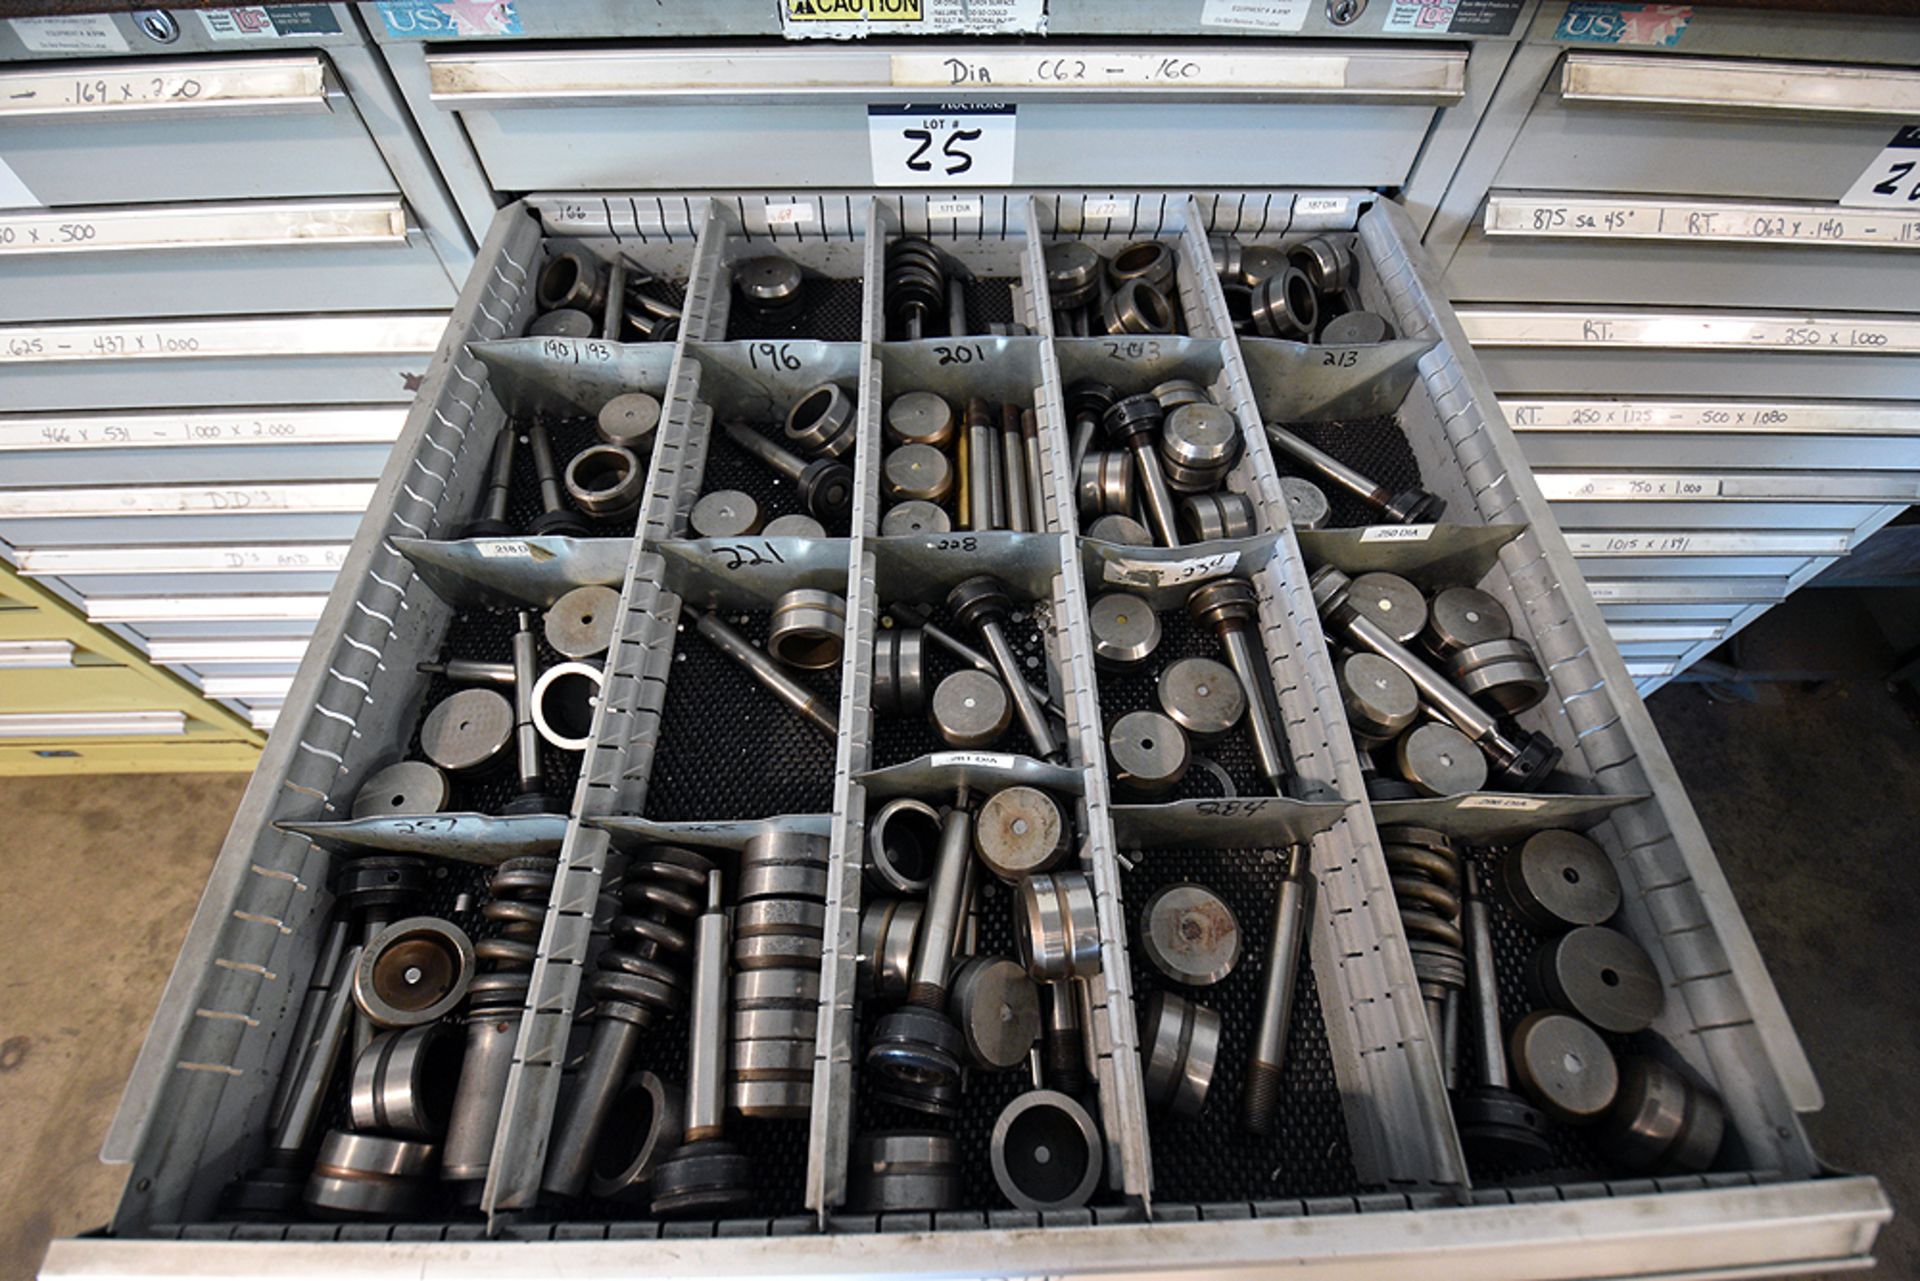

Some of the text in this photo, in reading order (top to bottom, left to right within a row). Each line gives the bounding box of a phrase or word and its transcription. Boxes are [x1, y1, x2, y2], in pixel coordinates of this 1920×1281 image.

[818, 0, 918, 12] CAUTION
[66, 80, 107, 103] .169
[923, 119, 945, 129] LOT
[903, 128, 982, 175] 25
[749, 342, 802, 372] 196
[932, 344, 985, 366] 201
[1322, 350, 1359, 368] 213
[711, 541, 785, 570] 221
[937, 537, 978, 552] 228
